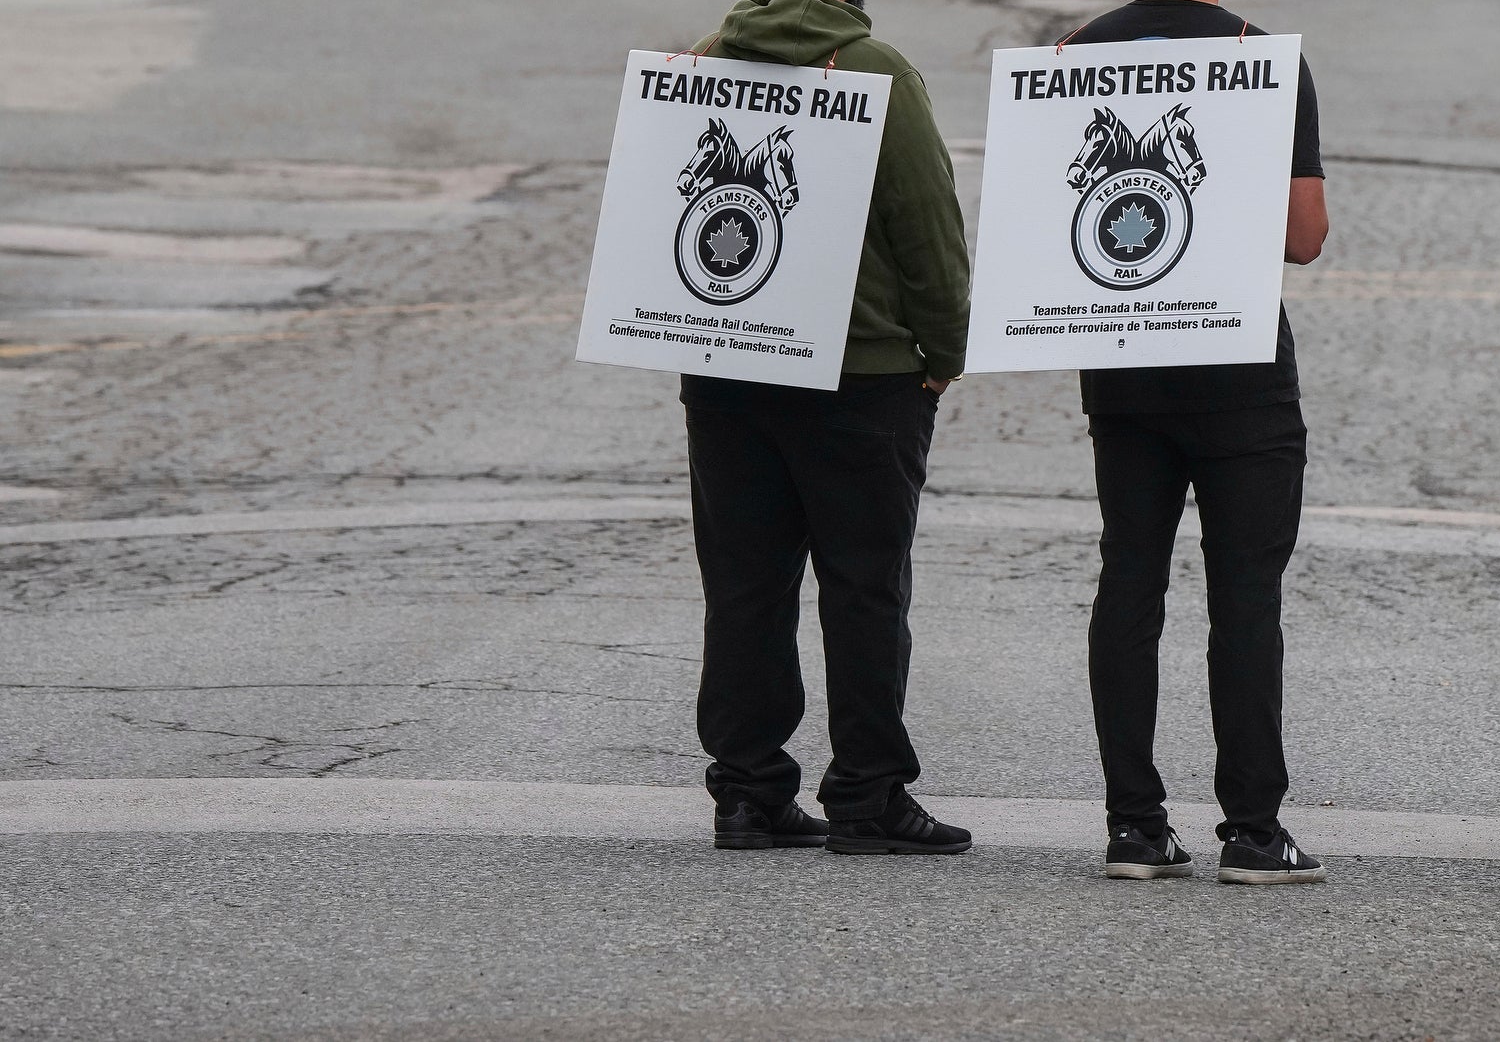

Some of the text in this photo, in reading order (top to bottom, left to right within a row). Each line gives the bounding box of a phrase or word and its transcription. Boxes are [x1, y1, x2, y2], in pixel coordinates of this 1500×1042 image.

[1010, 59, 1279, 100] TEAMSTERS RAIL
[640, 70, 872, 124] TEAMSTERS RAIL
[1096, 177, 1173, 203] TEAMSTERS
[700, 193, 768, 221] TEAMSTERS
[1114, 268, 1142, 279] RAIL
[707, 282, 732, 294] RAIL
[1033, 299, 1217, 317] Teamsters Canada Rail Conference
[634, 308, 794, 336] Teamsters Canada Rail Conference
[1005, 316, 1242, 336] Conférence ferroviaire de Teamsters Canada
[609, 324, 813, 358] Conférence ferroviaire de Teamsters Canada
